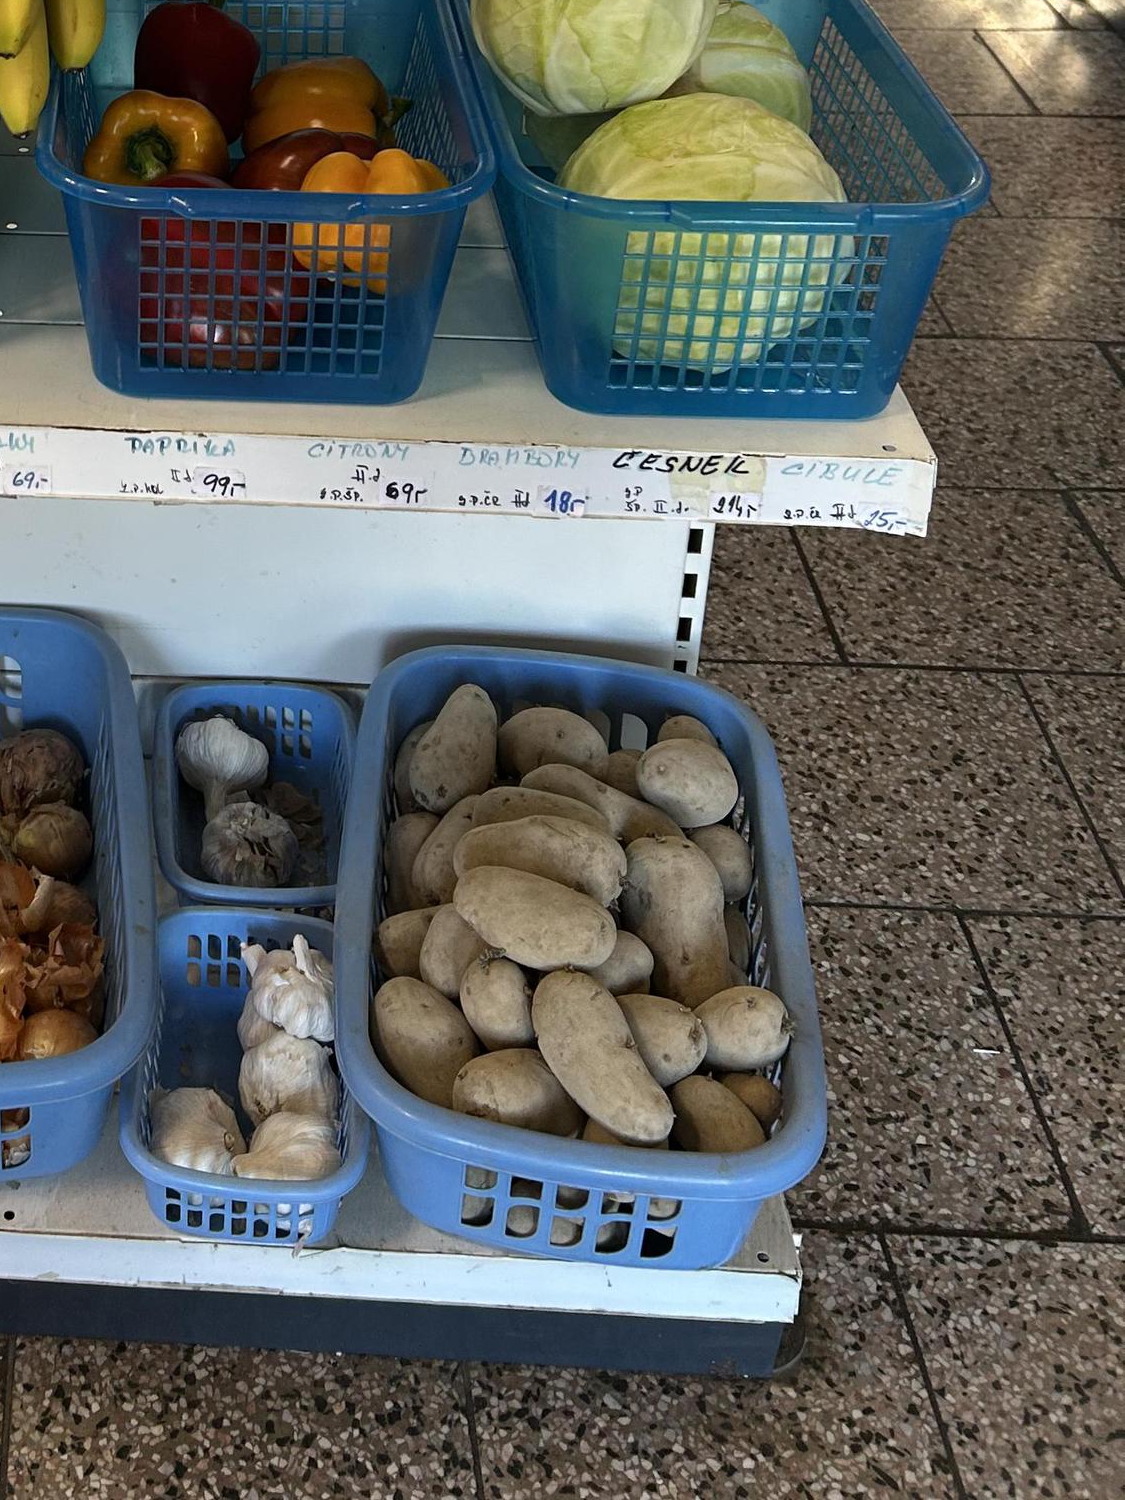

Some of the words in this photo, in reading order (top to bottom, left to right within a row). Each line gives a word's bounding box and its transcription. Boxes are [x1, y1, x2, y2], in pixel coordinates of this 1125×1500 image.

[11, 471, 49, 490] 69,-
[203, 473, 246, 497] 99,-
[781, 462, 904, 486] CIBULE
